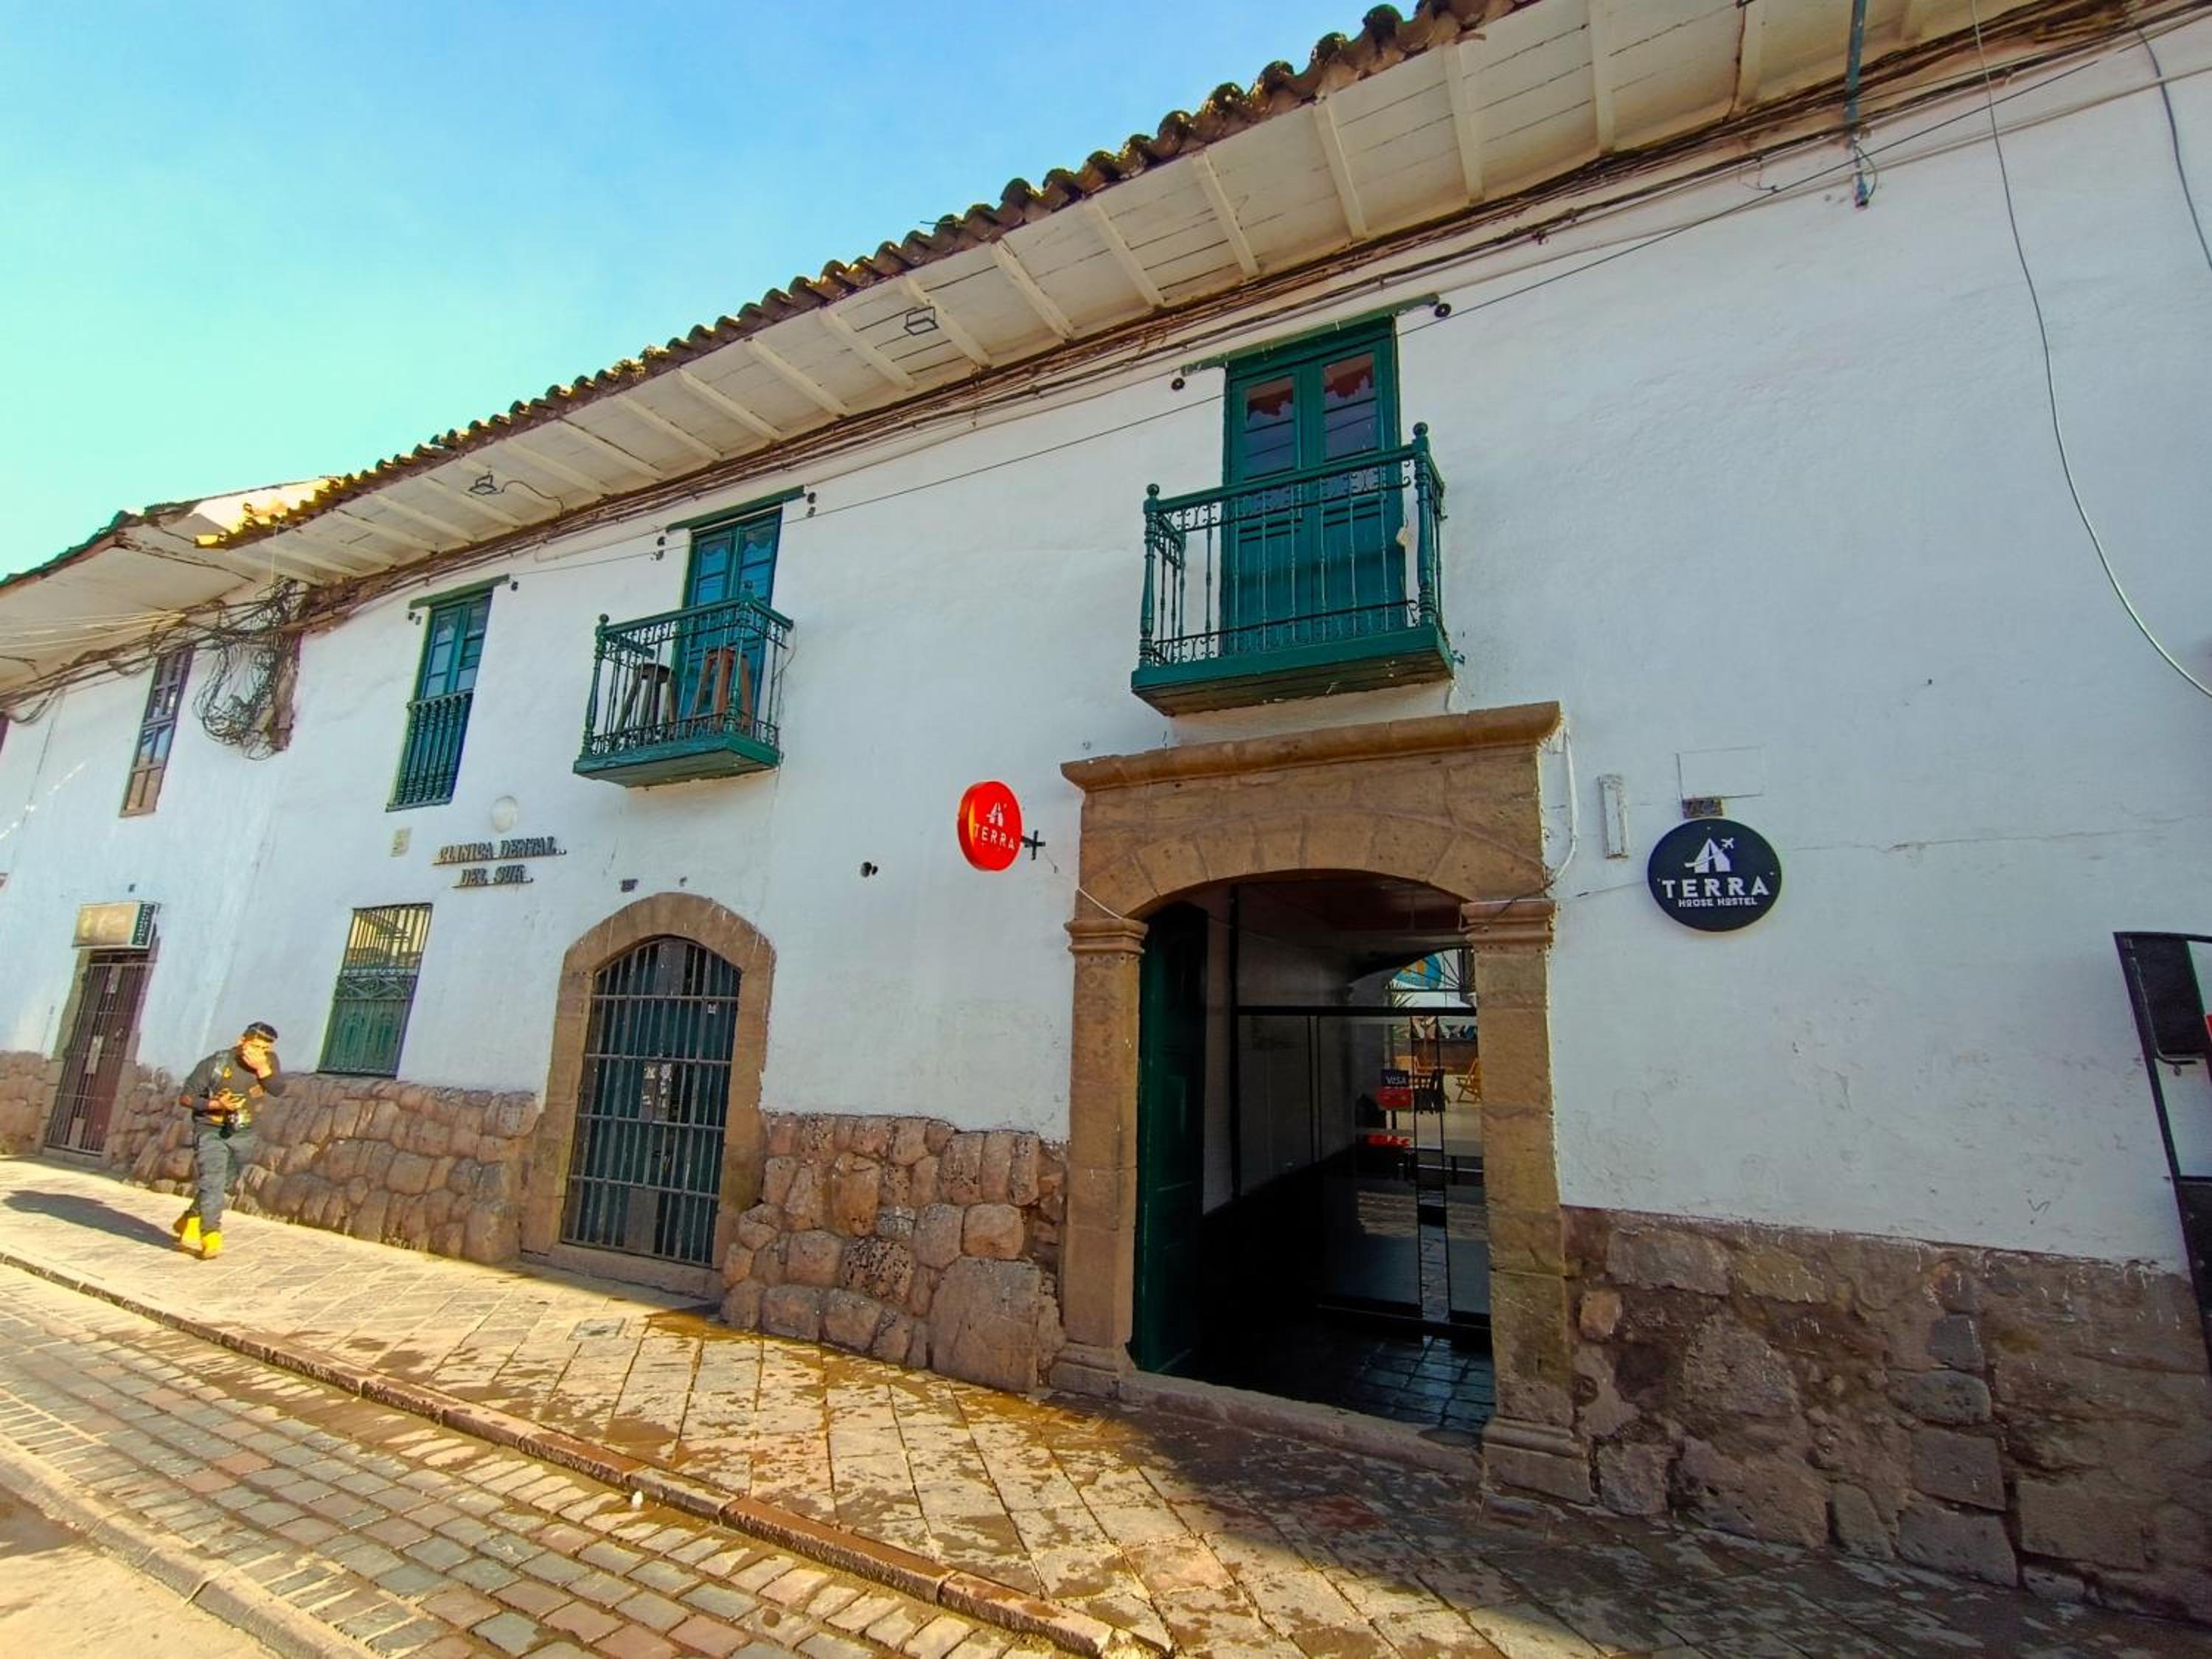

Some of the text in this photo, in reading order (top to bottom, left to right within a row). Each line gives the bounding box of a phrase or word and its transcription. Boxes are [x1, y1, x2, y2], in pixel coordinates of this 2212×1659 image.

[500, 836, 559, 858] DENTAL
[974, 823, 1015, 849] TERRA
[462, 864, 527, 886] DEL SUR
[1662, 876, 1770, 899] TERRA
[1678, 897, 1758, 908] HOUSE HOSTEL
[1387, 1076, 1407, 1085] VISA
